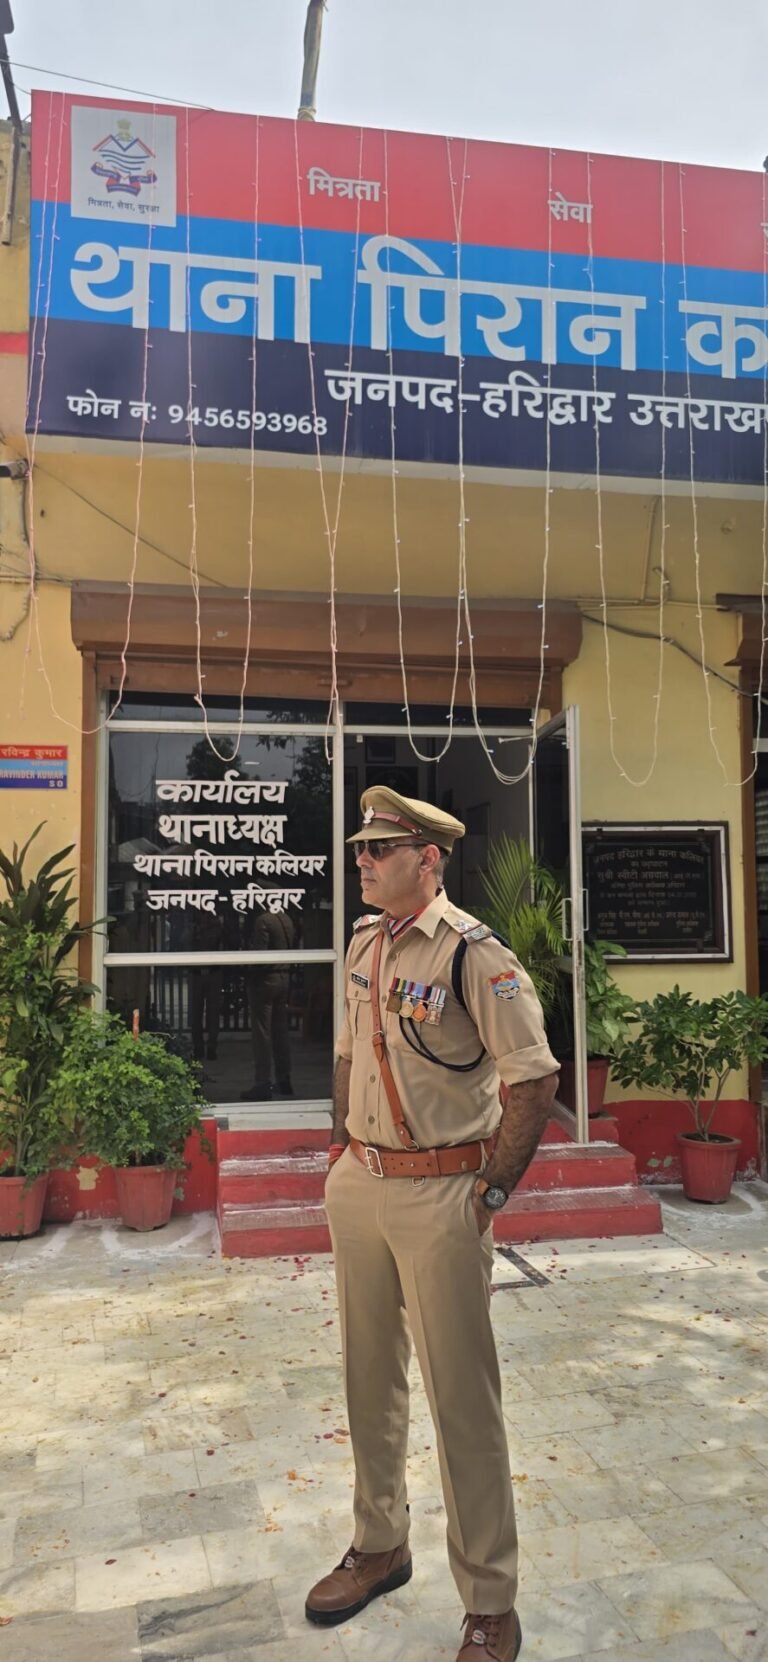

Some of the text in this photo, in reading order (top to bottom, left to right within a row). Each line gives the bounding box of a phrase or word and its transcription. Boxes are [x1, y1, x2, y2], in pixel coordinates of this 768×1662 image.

[307, 167, 593, 223] मित्रता सेवा
[70, 242, 322, 344] थाना
[357, 235, 647, 371] पिरान
[67, 389, 121, 419] फोन
[168, 404, 328, 436] 9456593968
[628, 394, 768, 434] उत्तराख
[156, 769, 289, 804] कार्यालय
[158, 815, 288, 848] थानाध्यक्ष
[133, 849, 327, 877] थाना पिरान कलियर
